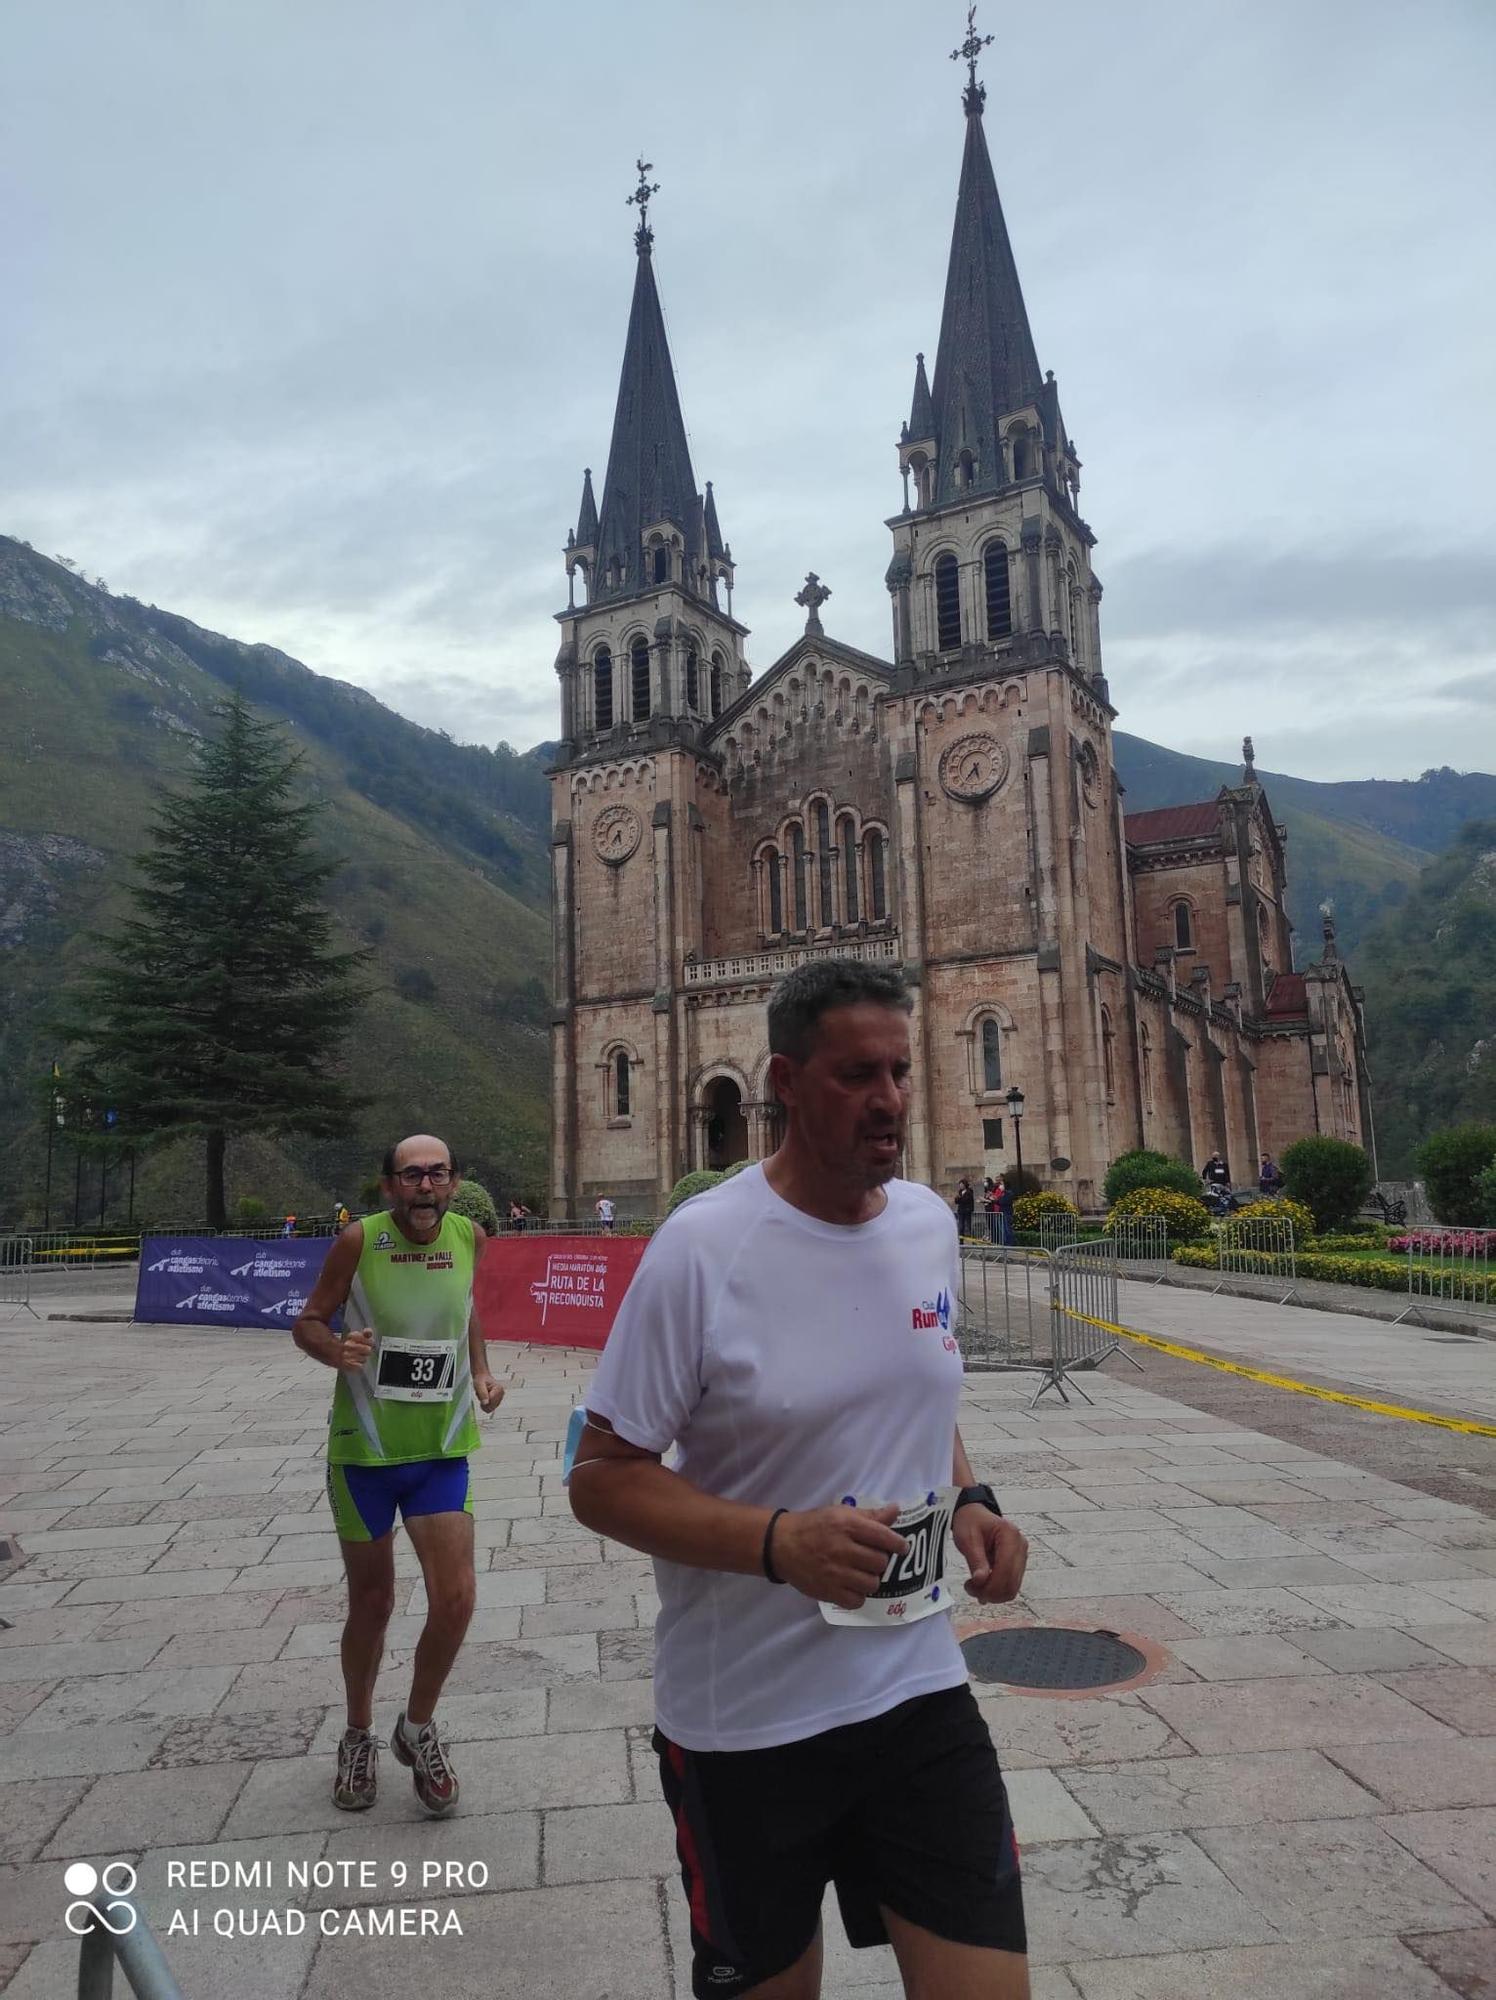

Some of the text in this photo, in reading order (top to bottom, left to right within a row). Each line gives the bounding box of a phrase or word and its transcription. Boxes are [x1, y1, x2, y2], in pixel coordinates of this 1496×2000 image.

[551, 1275, 605, 1292] RUTA DE LA
[549, 1292, 604, 1308] RECONQUISTA
[411, 1358, 435, 1382] 33
